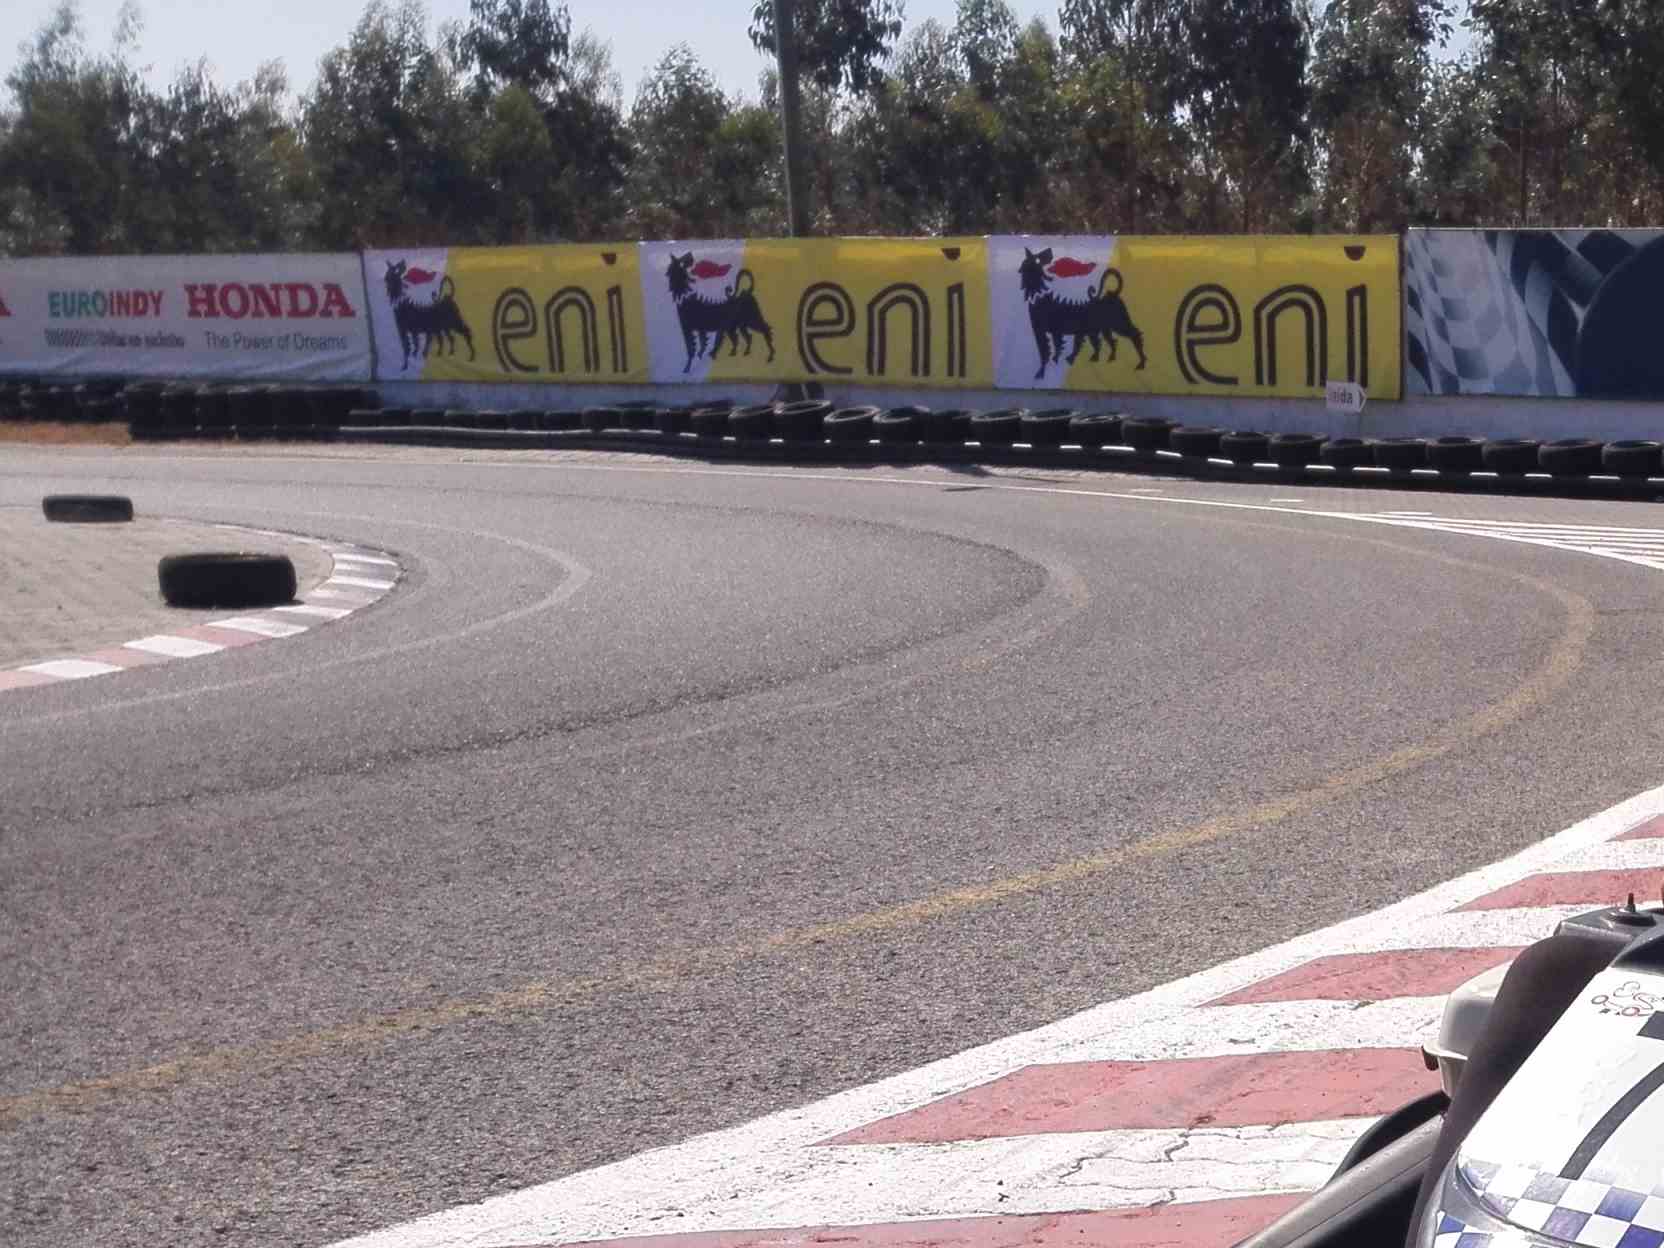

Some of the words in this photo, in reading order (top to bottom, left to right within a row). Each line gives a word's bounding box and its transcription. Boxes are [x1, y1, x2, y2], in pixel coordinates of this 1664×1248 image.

[183, 283, 357, 319] HONDA
[204, 331, 230, 350] The
[231, 331, 273, 351] Power
[276, 332, 291, 350] of
[292, 332, 349, 351] Dreams
[493, 252, 629, 374] eni
[797, 247, 967, 379] eni
[1174, 245, 1369, 388] eni
